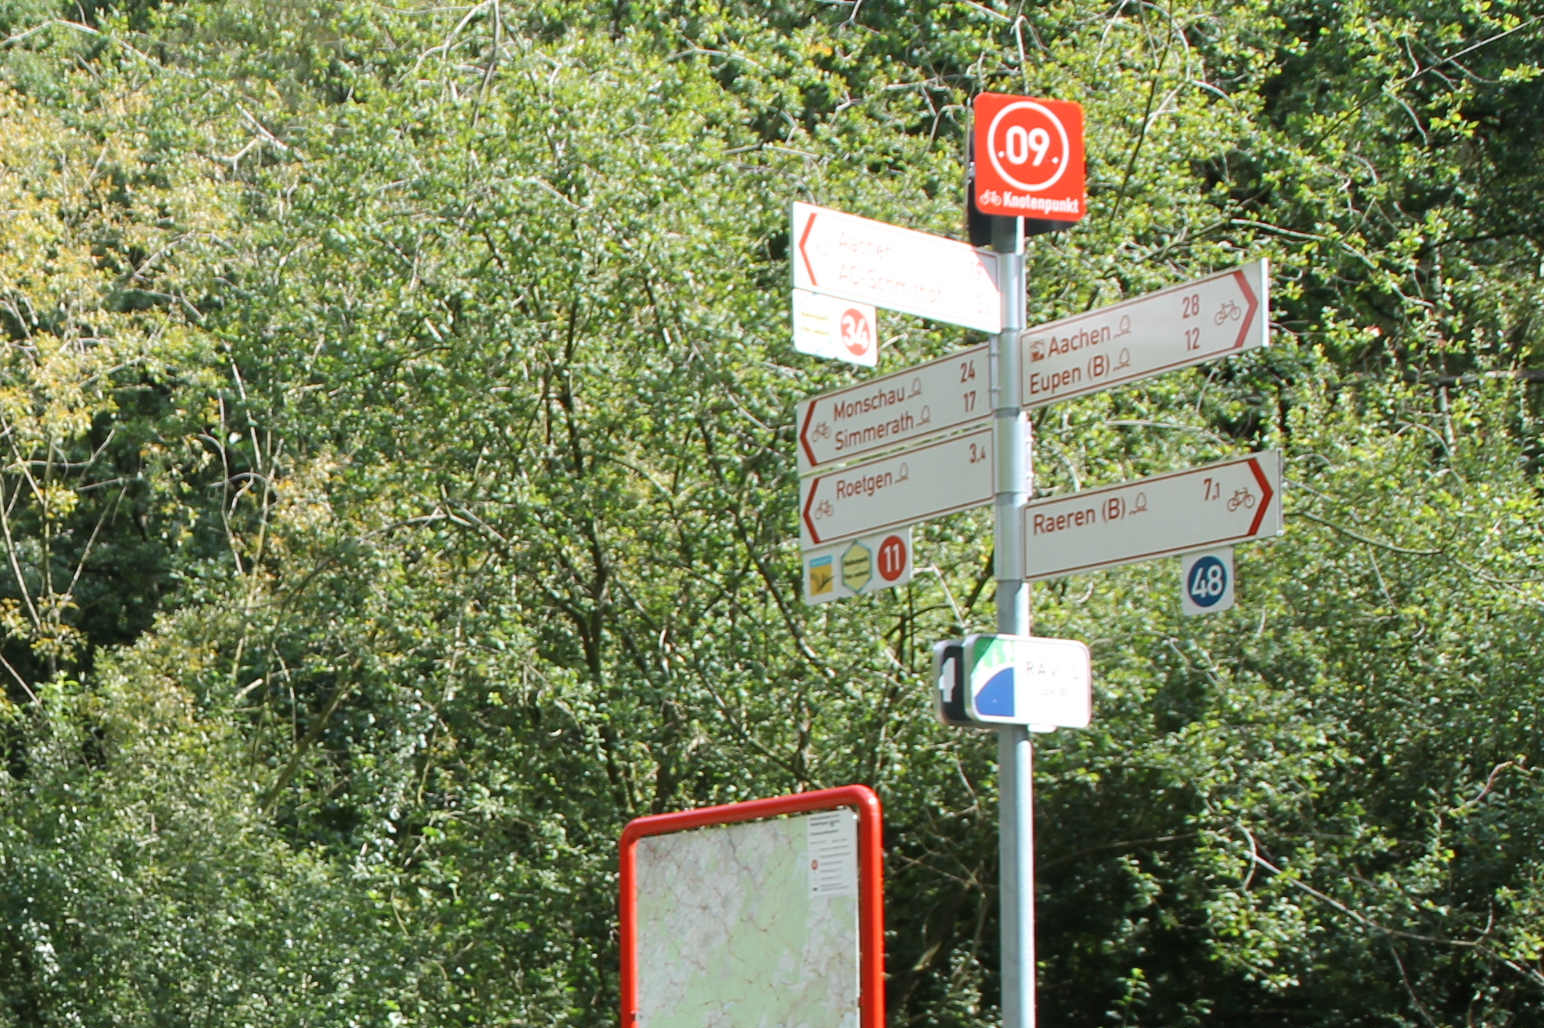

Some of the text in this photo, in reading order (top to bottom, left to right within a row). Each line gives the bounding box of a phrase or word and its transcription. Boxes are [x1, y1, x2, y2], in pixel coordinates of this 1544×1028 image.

[1002, 190, 1080, 215] Knotenpunkt
[838, 231, 894, 260] Aachen
[842, 314, 870, 352] 34
[1048, 293, 1200, 358] Aachen 28
[1030, 327, 1201, 395] Eupen (B) 12
[833, 360, 975, 422] Monschau 24
[835, 390, 976, 451] Simmerath 17
[836, 472, 893, 500] Roetgen
[1033, 477, 1220, 536] Raeren (B) 7,1
[884, 543, 901, 573] 11
[1191, 564, 1223, 598] 48
[1026, 661, 1079, 680] RAVL
